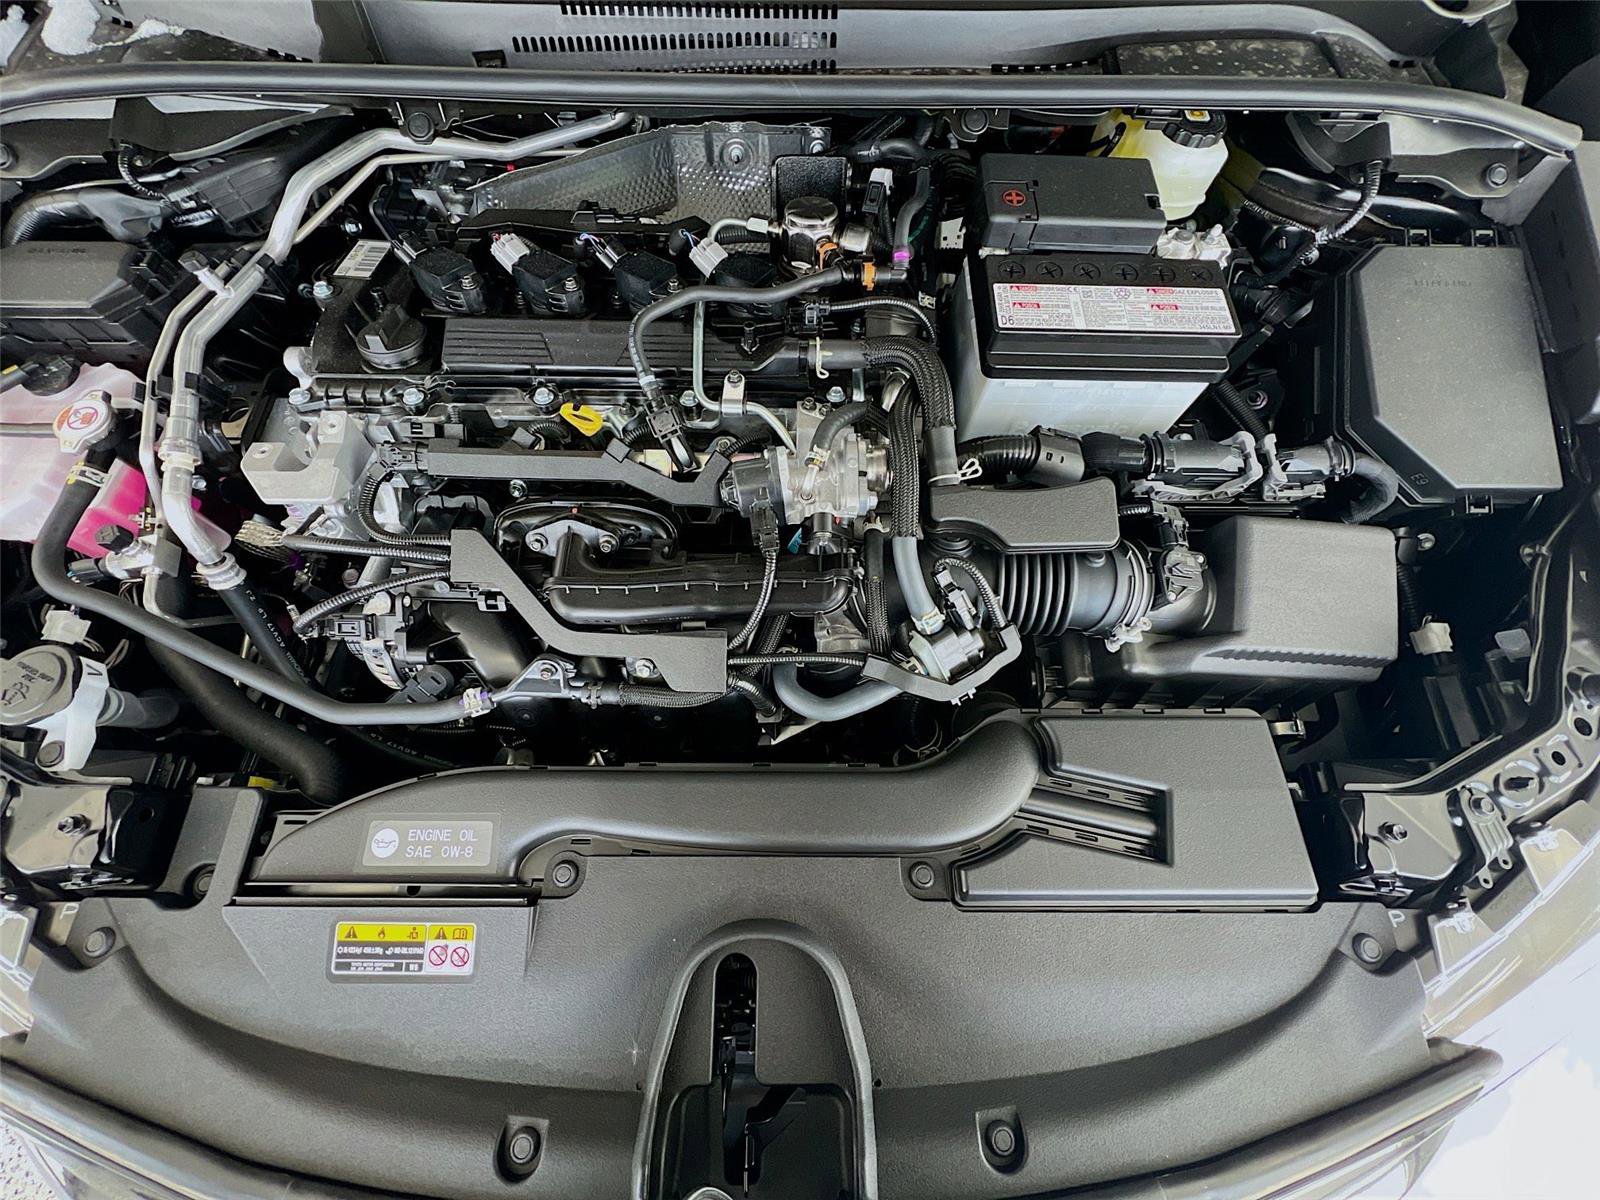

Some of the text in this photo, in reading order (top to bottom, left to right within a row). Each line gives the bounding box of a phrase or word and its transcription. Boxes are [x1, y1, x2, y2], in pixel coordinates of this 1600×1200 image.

[1001, 315, 1015, 326] D6
[245, 589, 256, 602] ZJ
[266, 622, 286, 648] ACV17
[408, 828, 479, 842] ENGINE OIL
[405, 845, 474, 858] SAE 0W-8
